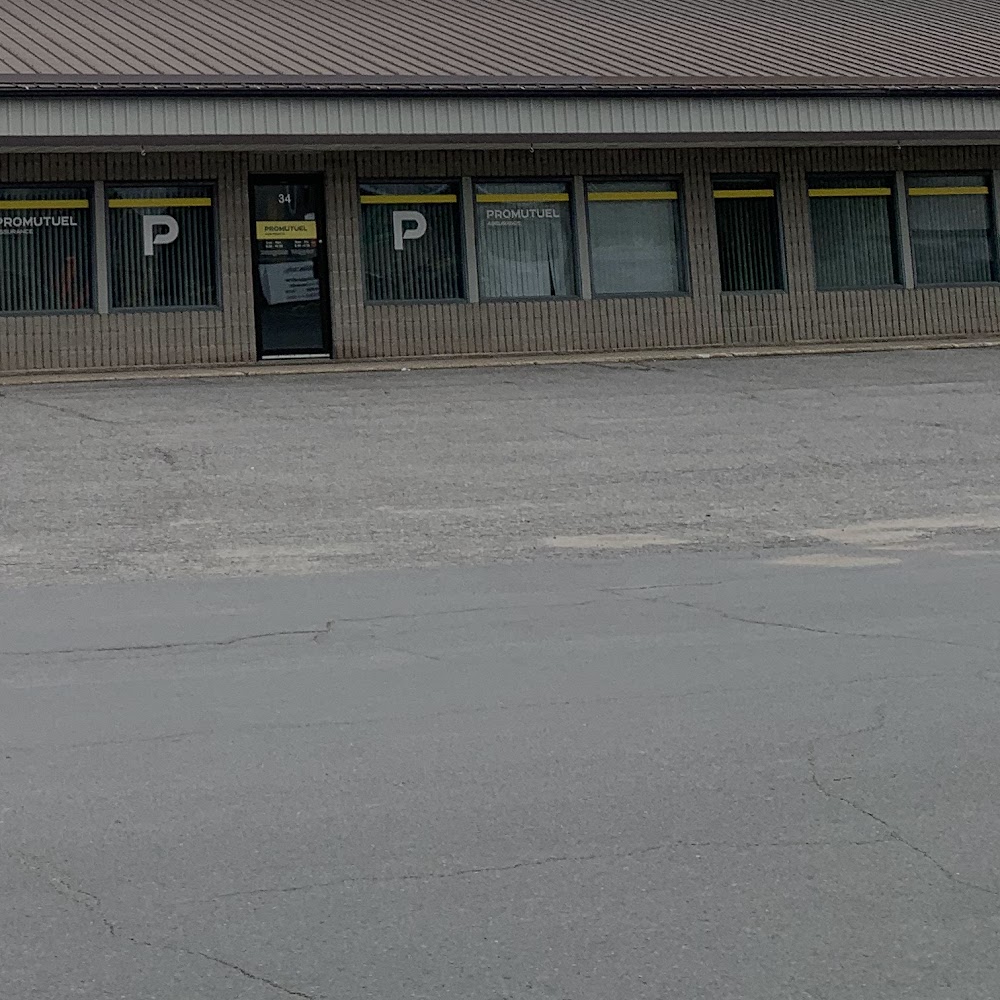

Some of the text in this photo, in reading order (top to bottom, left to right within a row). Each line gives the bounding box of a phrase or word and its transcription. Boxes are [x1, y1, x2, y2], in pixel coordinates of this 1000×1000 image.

[278, 193, 291, 204] 34
[486, 208, 560, 219] PROMUTUEL
[142, 214, 179, 256] P
[392, 210, 427, 250] P
